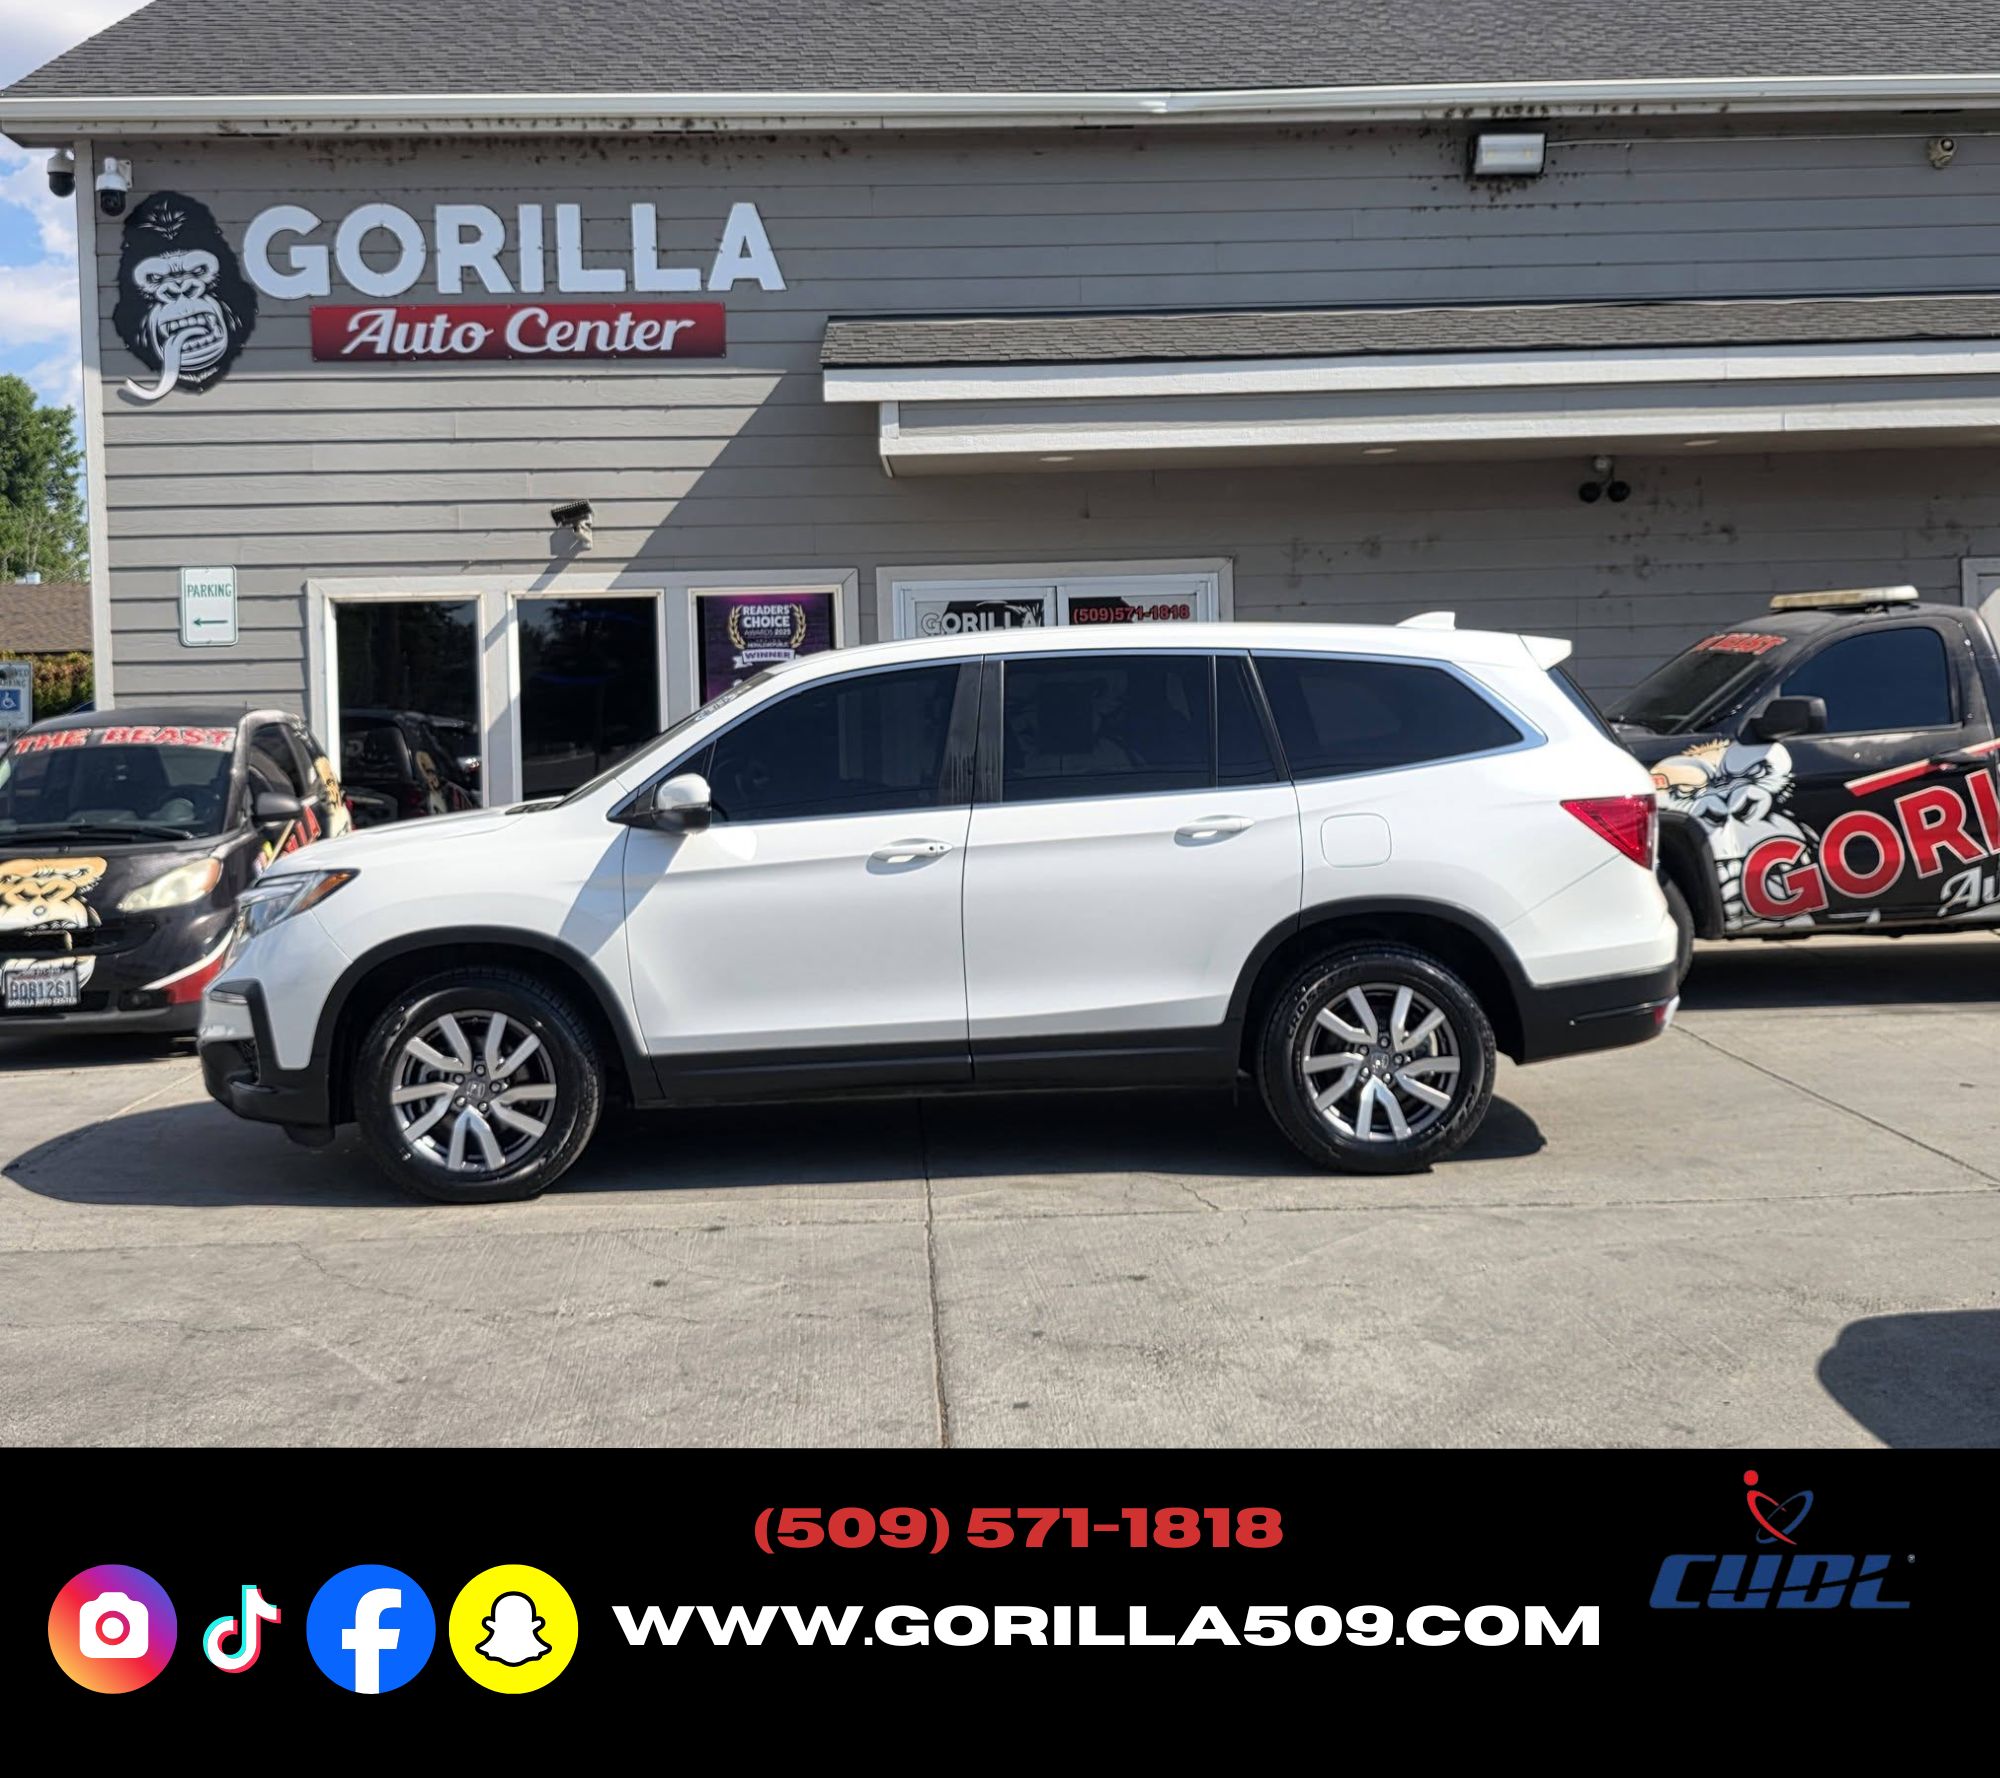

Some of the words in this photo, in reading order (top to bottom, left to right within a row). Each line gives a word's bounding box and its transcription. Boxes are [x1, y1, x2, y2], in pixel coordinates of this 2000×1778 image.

[242, 202, 787, 299] GORILLA
[341, 308, 495, 356] Auto
[505, 308, 695, 354] Center
[187, 584, 232, 598] PARKING
[743, 616, 791, 628] CHOICE
[921, 611, 1037, 635] GORILLA
[1073, 604, 1191, 624] (509)571-1818
[15, 728, 91, 755] THE
[102, 726, 236, 749] BEAST
